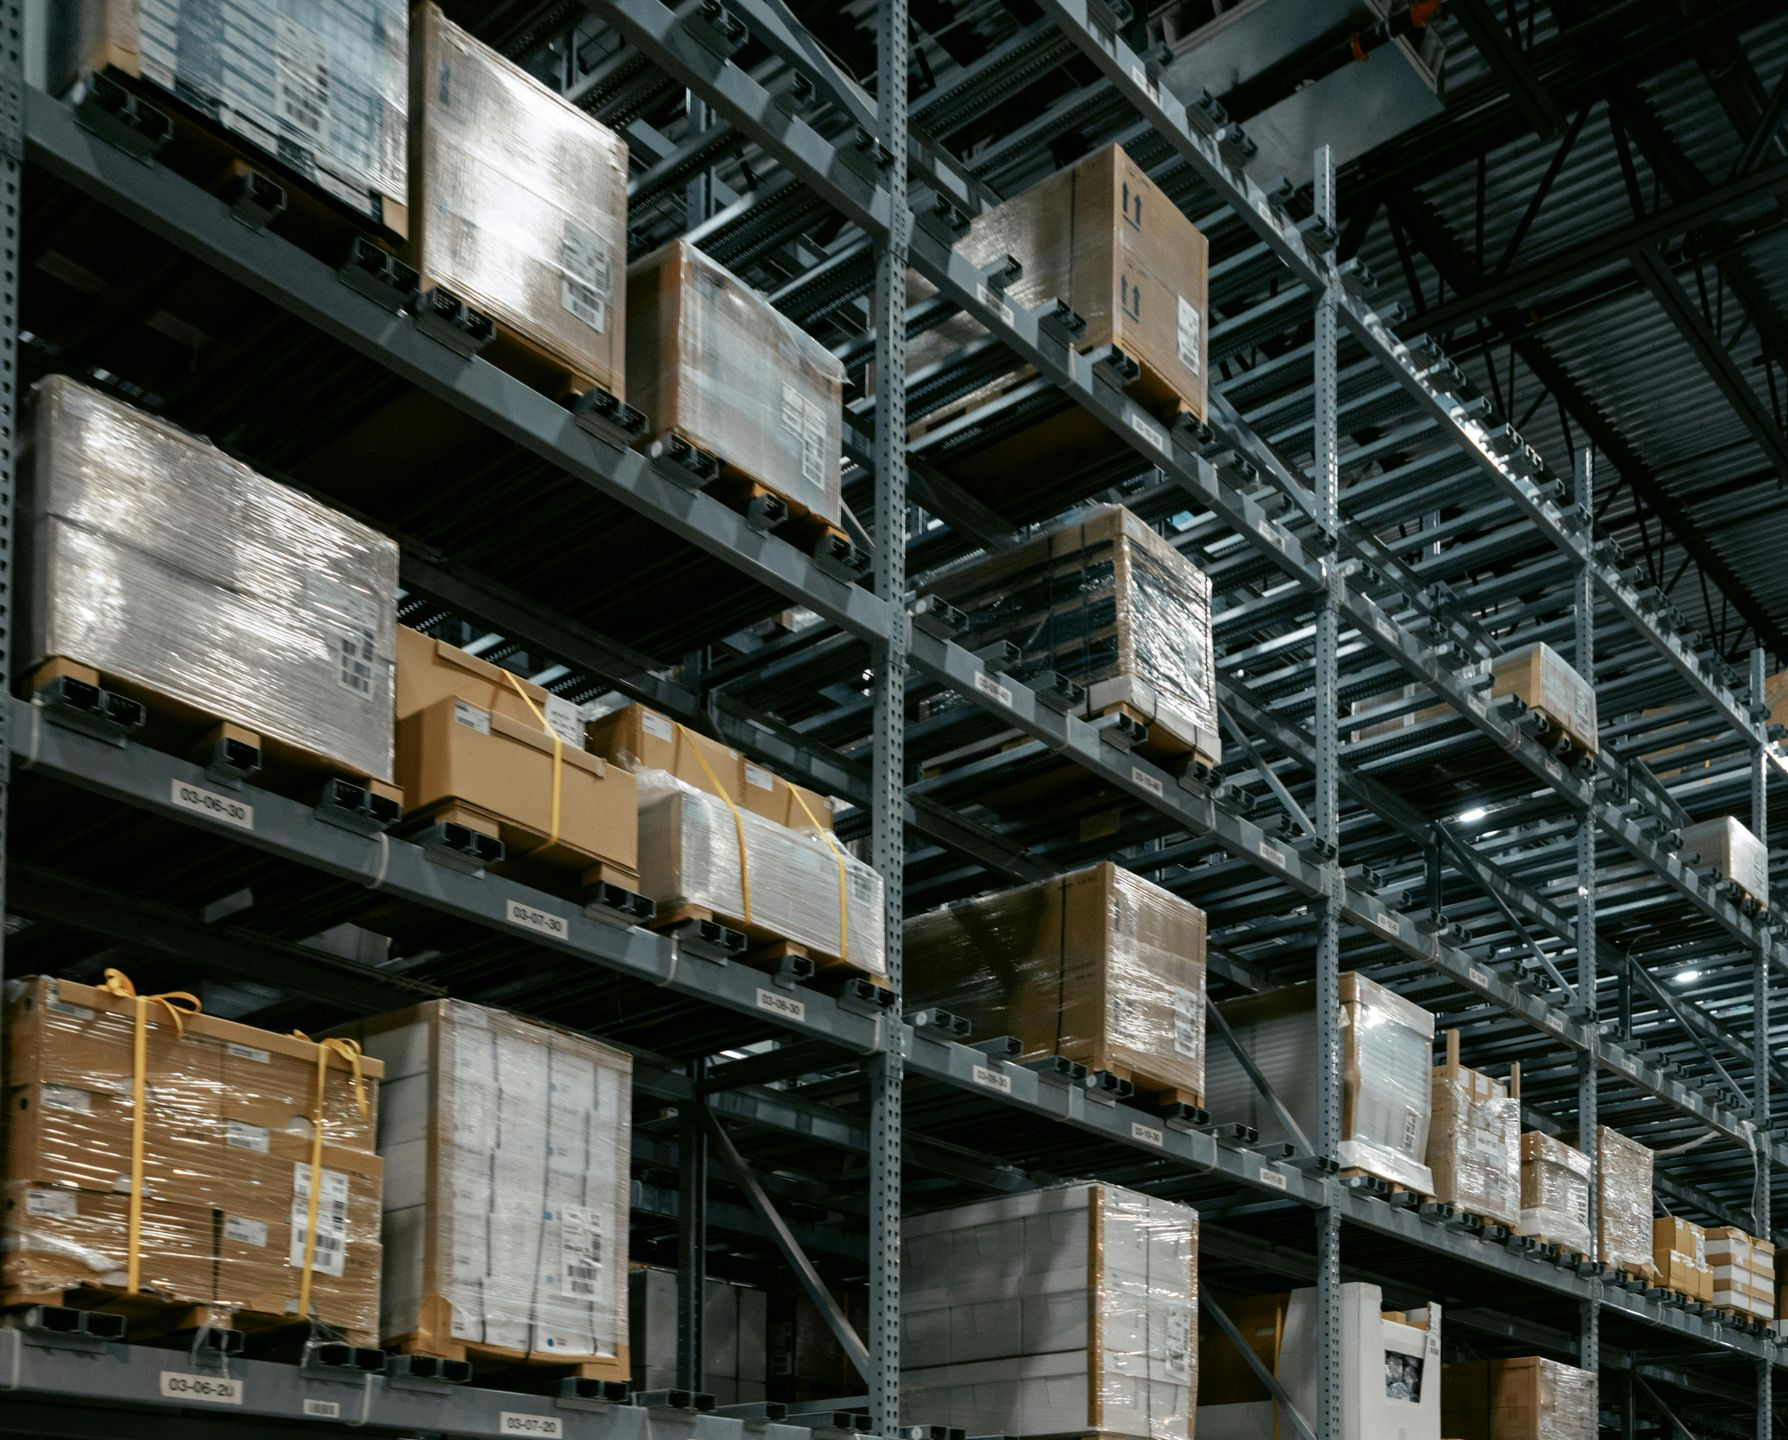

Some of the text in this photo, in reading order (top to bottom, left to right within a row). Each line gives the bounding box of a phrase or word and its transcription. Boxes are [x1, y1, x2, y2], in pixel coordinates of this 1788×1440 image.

[180, 787, 245, 820] 03-06-30
[513, 906, 562, 933] 03-07-30
[761, 993, 800, 1015] 03-08-30
[169, 1378, 235, 1397] 03-06-20
[507, 1417, 556, 1433] 03-07-20
